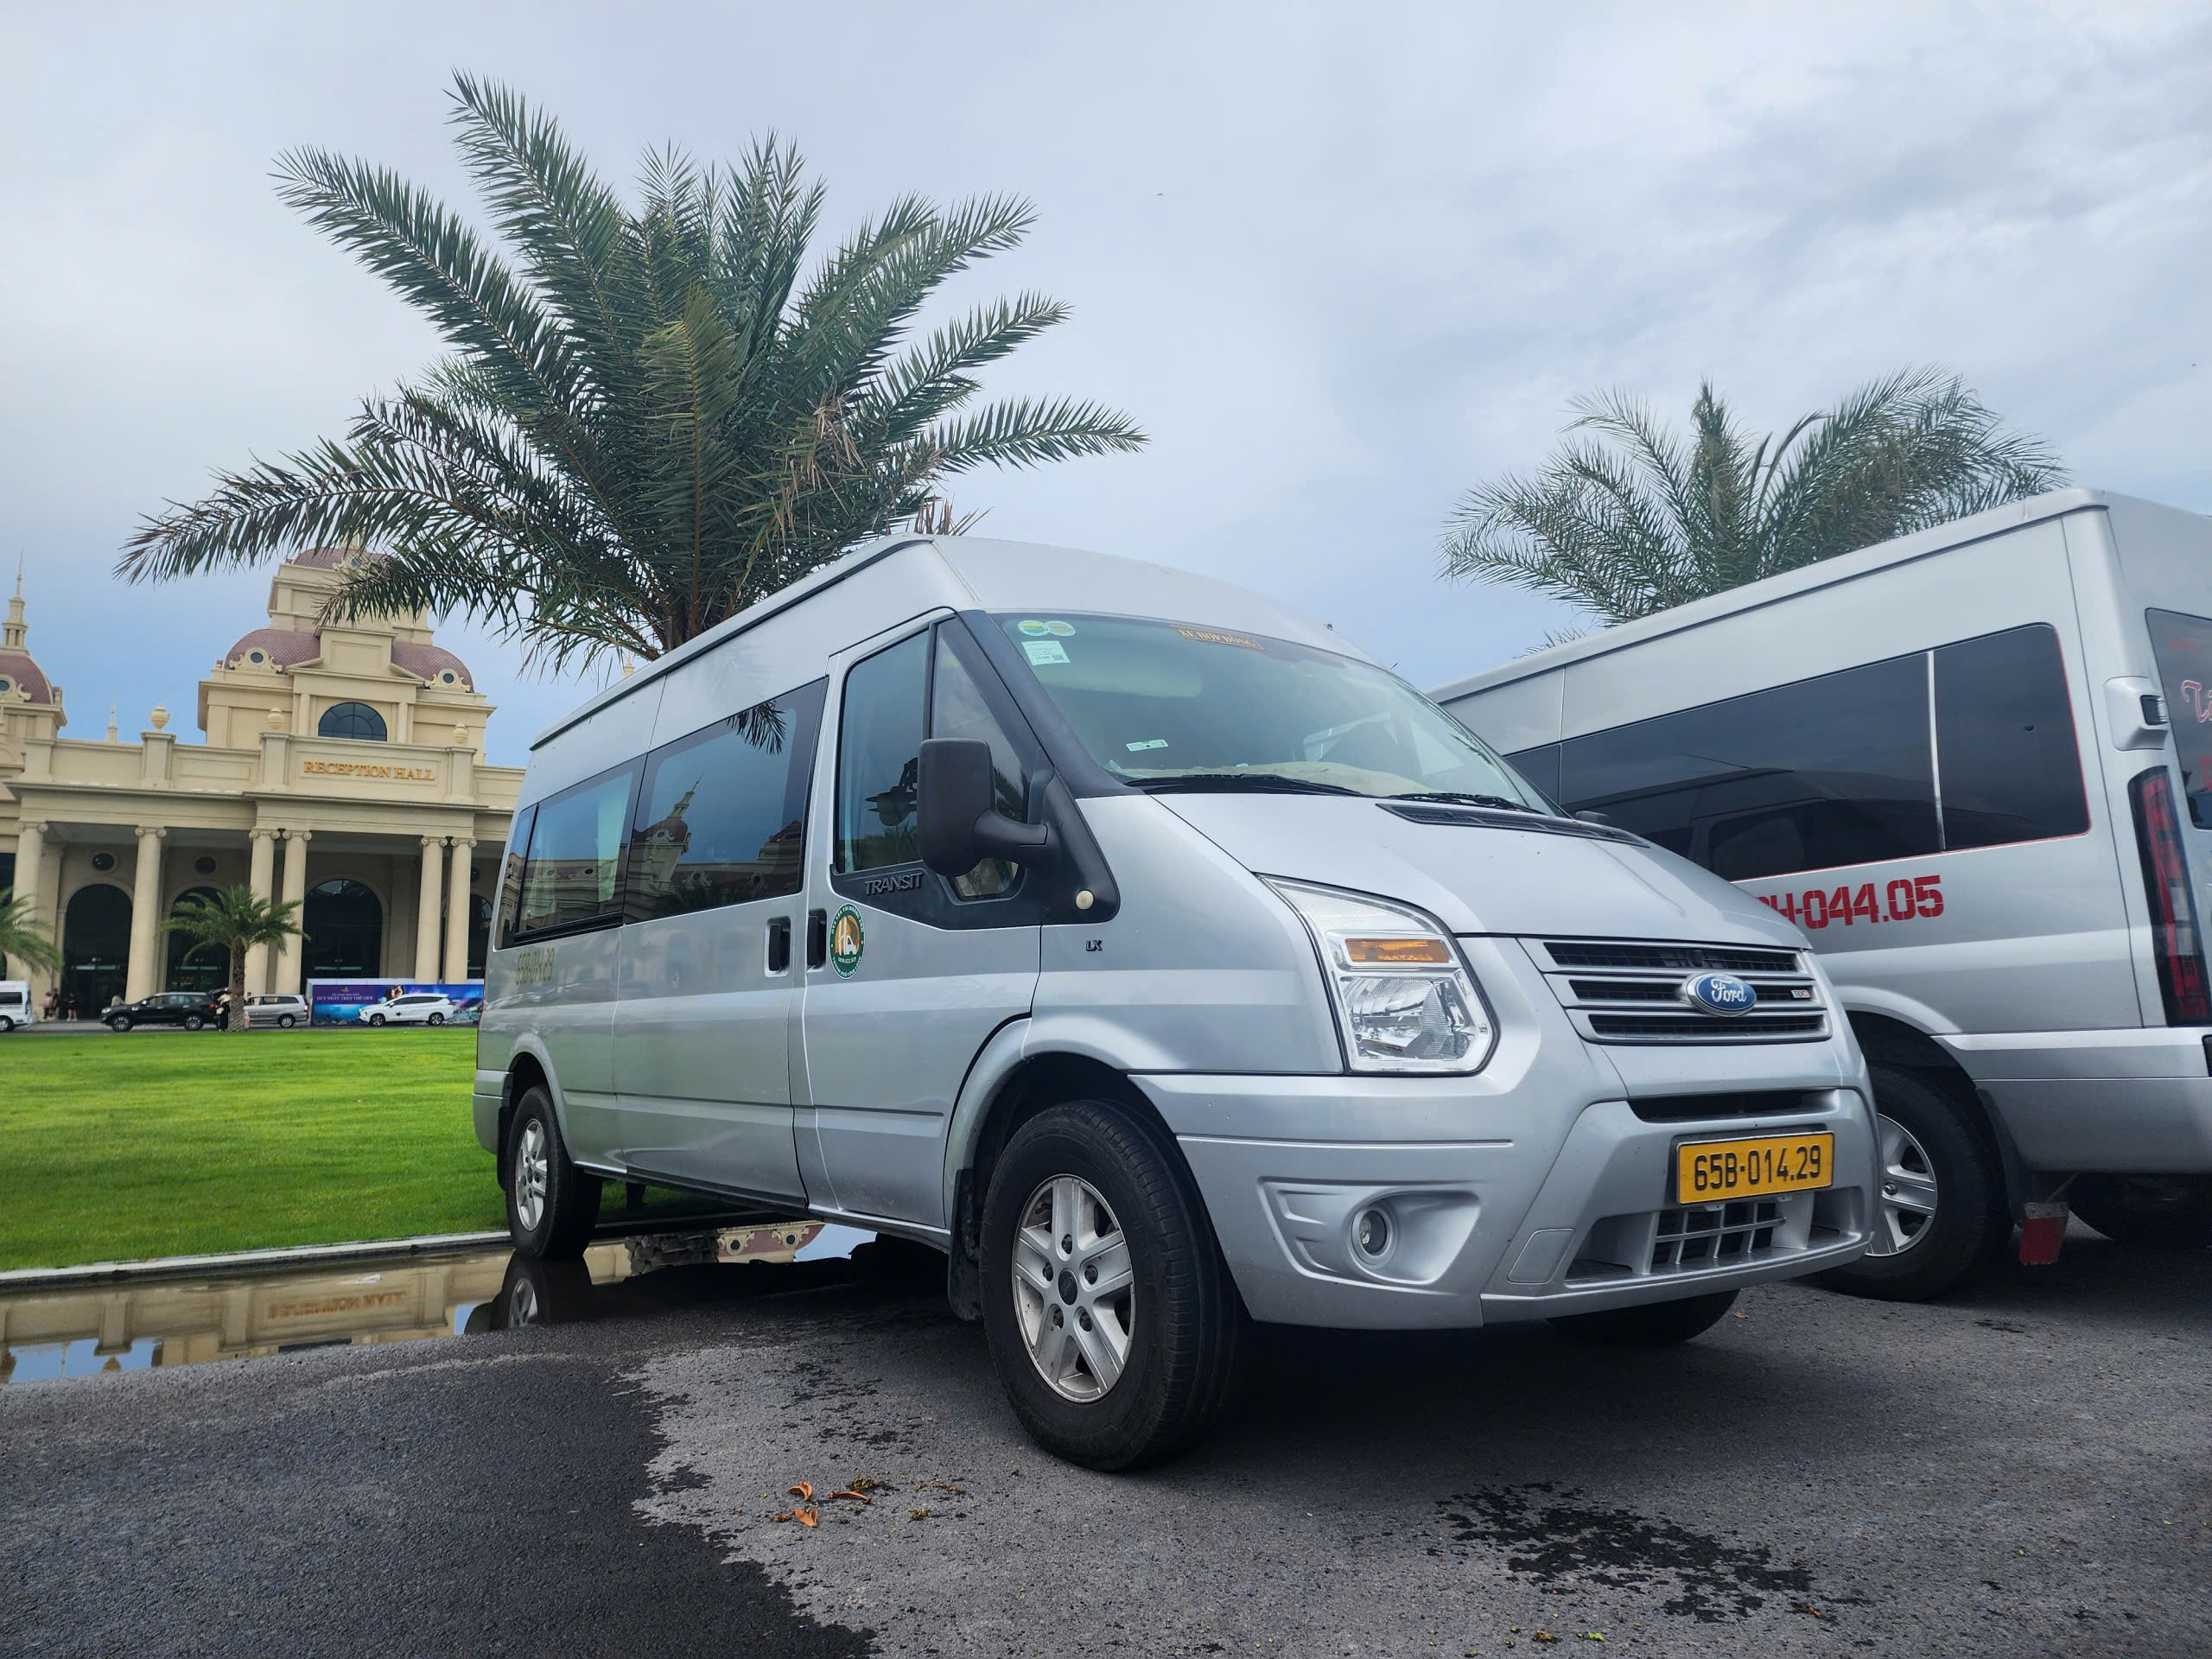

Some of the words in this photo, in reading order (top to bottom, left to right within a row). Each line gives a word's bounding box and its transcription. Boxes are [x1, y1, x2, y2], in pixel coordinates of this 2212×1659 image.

[303, 760, 391, 778] RECEPTION
[393, 766, 436, 781] HALL
[864, 872, 923, 895] TRANSIT
[1086, 939, 1103, 951] LX
[1711, 978, 1747, 1003] Ford
[1694, 1145, 1821, 1192] 65B-014.29
